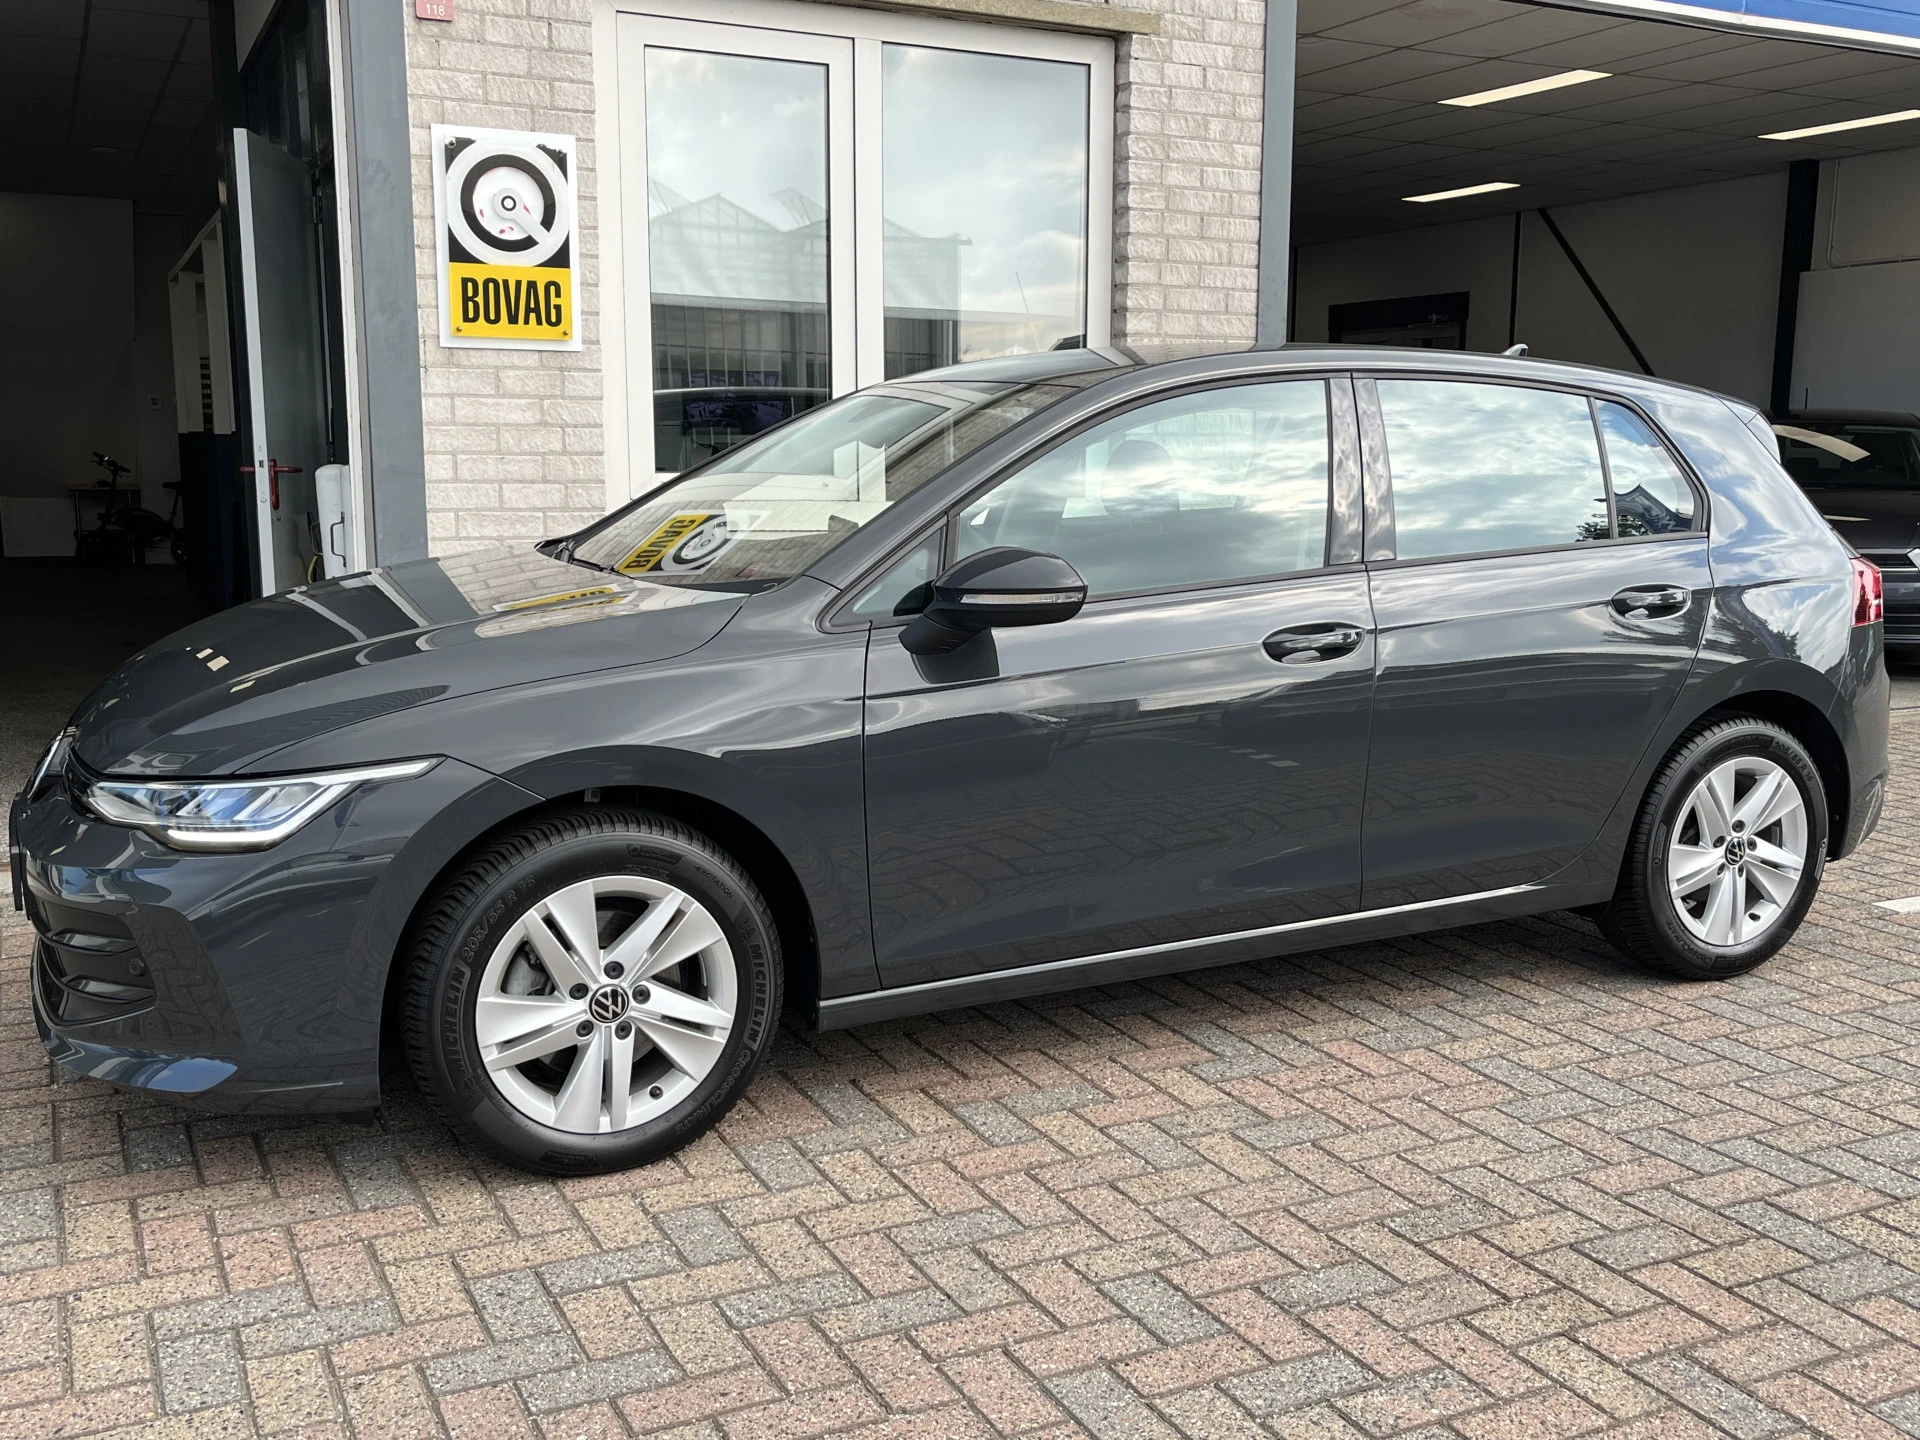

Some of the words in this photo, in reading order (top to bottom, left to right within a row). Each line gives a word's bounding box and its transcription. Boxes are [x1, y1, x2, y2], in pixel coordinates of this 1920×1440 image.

[426, 4, 445, 16] 118
[461, 276, 562, 328] BOVAG
[700, 869, 734, 899] ROTATION
[462, 899, 506, 963] 205/55
[504, 889, 519, 907] R
[519, 874, 537, 896] 16
[748, 942, 769, 1044] MICHELIN
